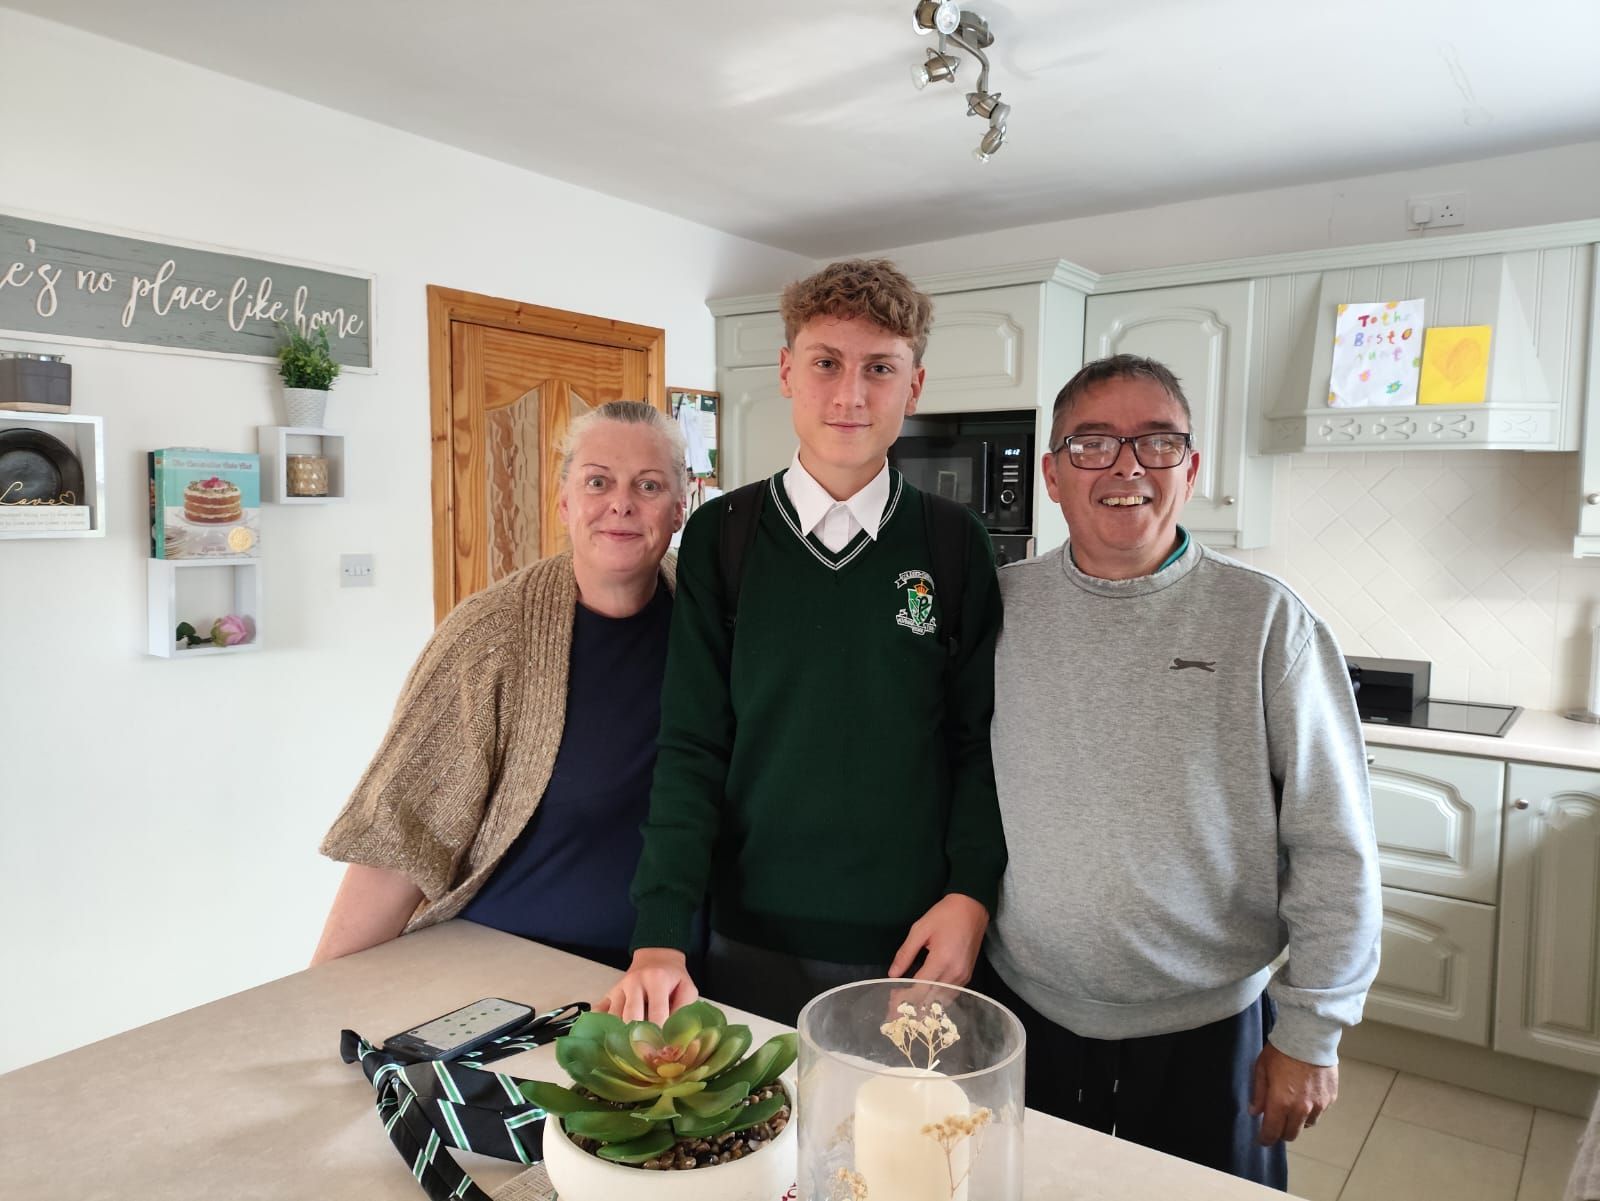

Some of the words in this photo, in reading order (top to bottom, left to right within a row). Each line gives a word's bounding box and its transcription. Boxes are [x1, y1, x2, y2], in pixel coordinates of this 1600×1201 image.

[0, 238, 62, 317] e's
[77, 270, 117, 294] no
[121, 259, 223, 328] place
[228, 276, 289, 332] like
[294, 285, 364, 340] home
[1357, 314, 1378, 328] To
